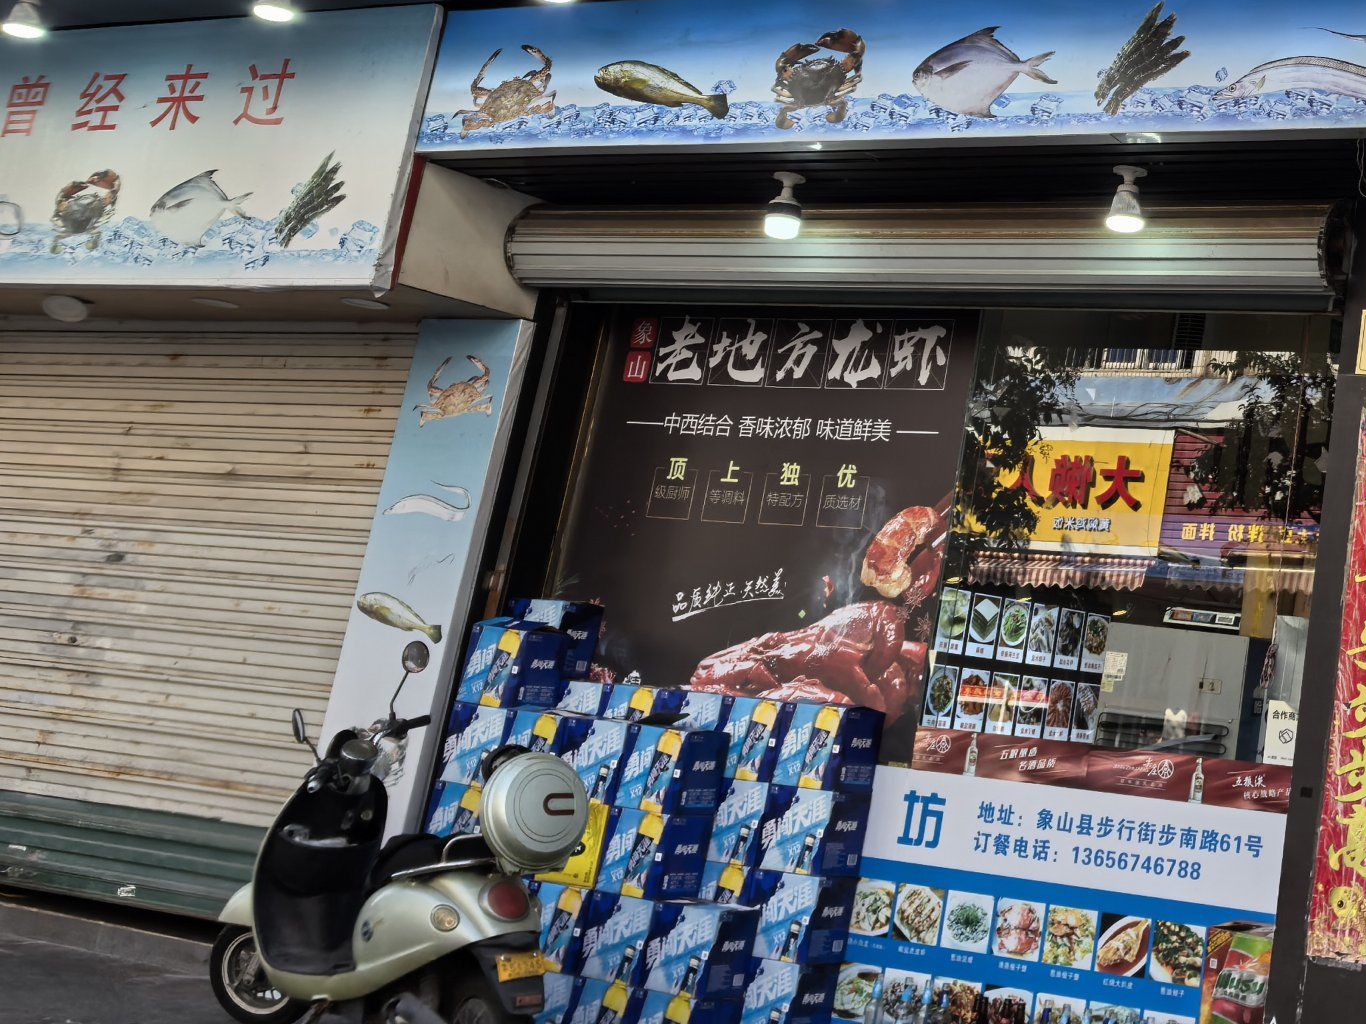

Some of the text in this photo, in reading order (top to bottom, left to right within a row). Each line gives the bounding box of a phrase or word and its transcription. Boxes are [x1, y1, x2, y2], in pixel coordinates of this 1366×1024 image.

[1, 58, 296, 138] 曾经来过
[655, 315, 948, 389] 老地方龙虾
[663, 413, 893, 442] 中西结合 香味浓郁 味道鲜美
[761, 794, 829, 852] 勇闯天涯
[897, 789, 947, 850] 坊
[646, 914, 714, 970] 勇闯天涯
